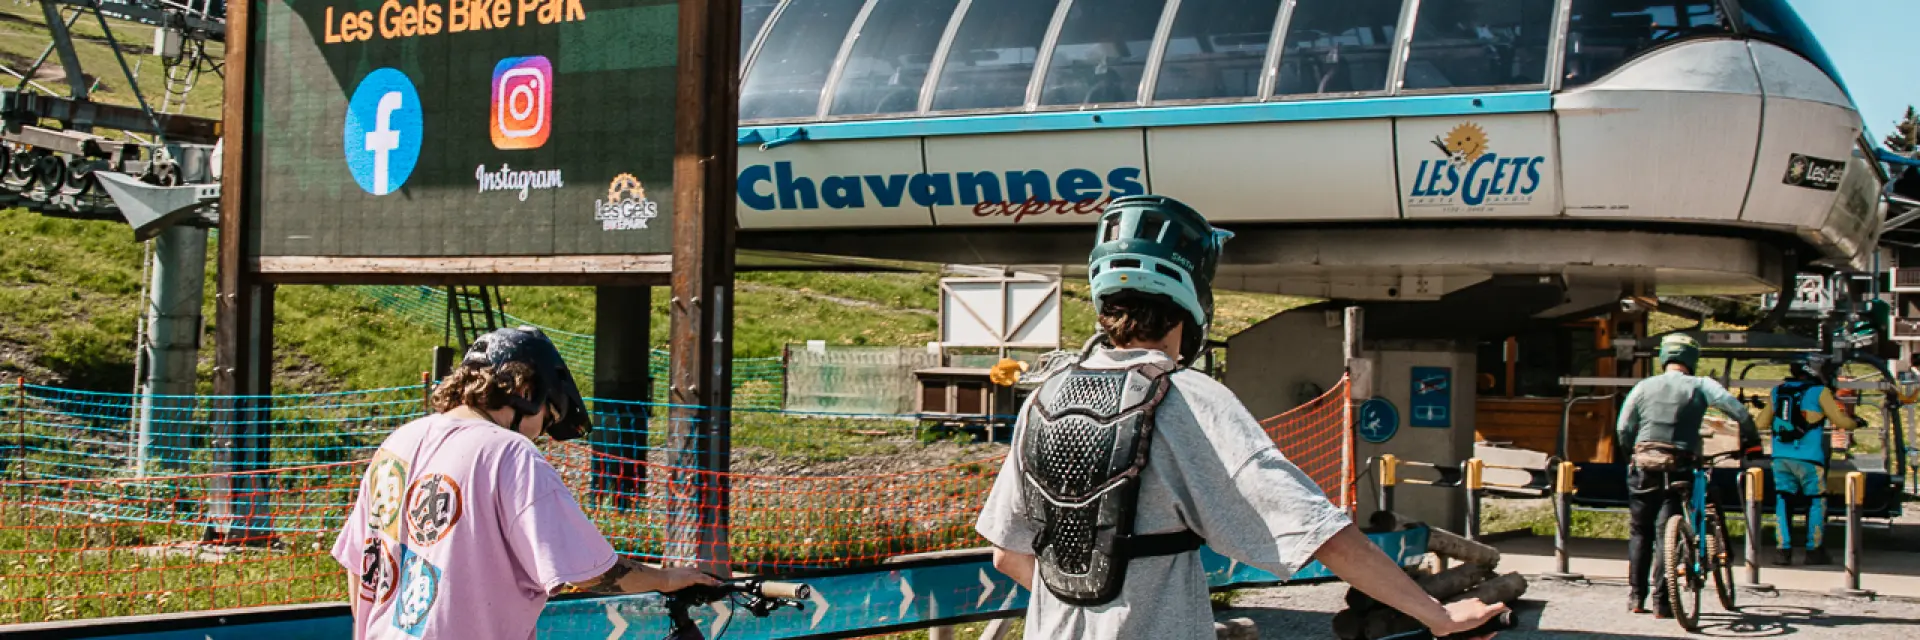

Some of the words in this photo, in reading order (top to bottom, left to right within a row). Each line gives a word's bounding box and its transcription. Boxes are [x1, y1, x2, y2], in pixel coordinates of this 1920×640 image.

[324, 6, 373, 43] Les
[379, 0, 442, 39] Gets
[448, 0, 511, 33] Bike
[517, 0, 586, 26] Park
[475, 163, 564, 201] Instagram
[736, 161, 1145, 211] Chavannes
[1410, 159, 1460, 196] LES
[1461, 153, 1545, 206] GETS
[1806, 161, 1827, 182] Les
[595, 199, 621, 220] Les
[621, 198, 658, 219] Gets
[972, 194, 1113, 223] expres
